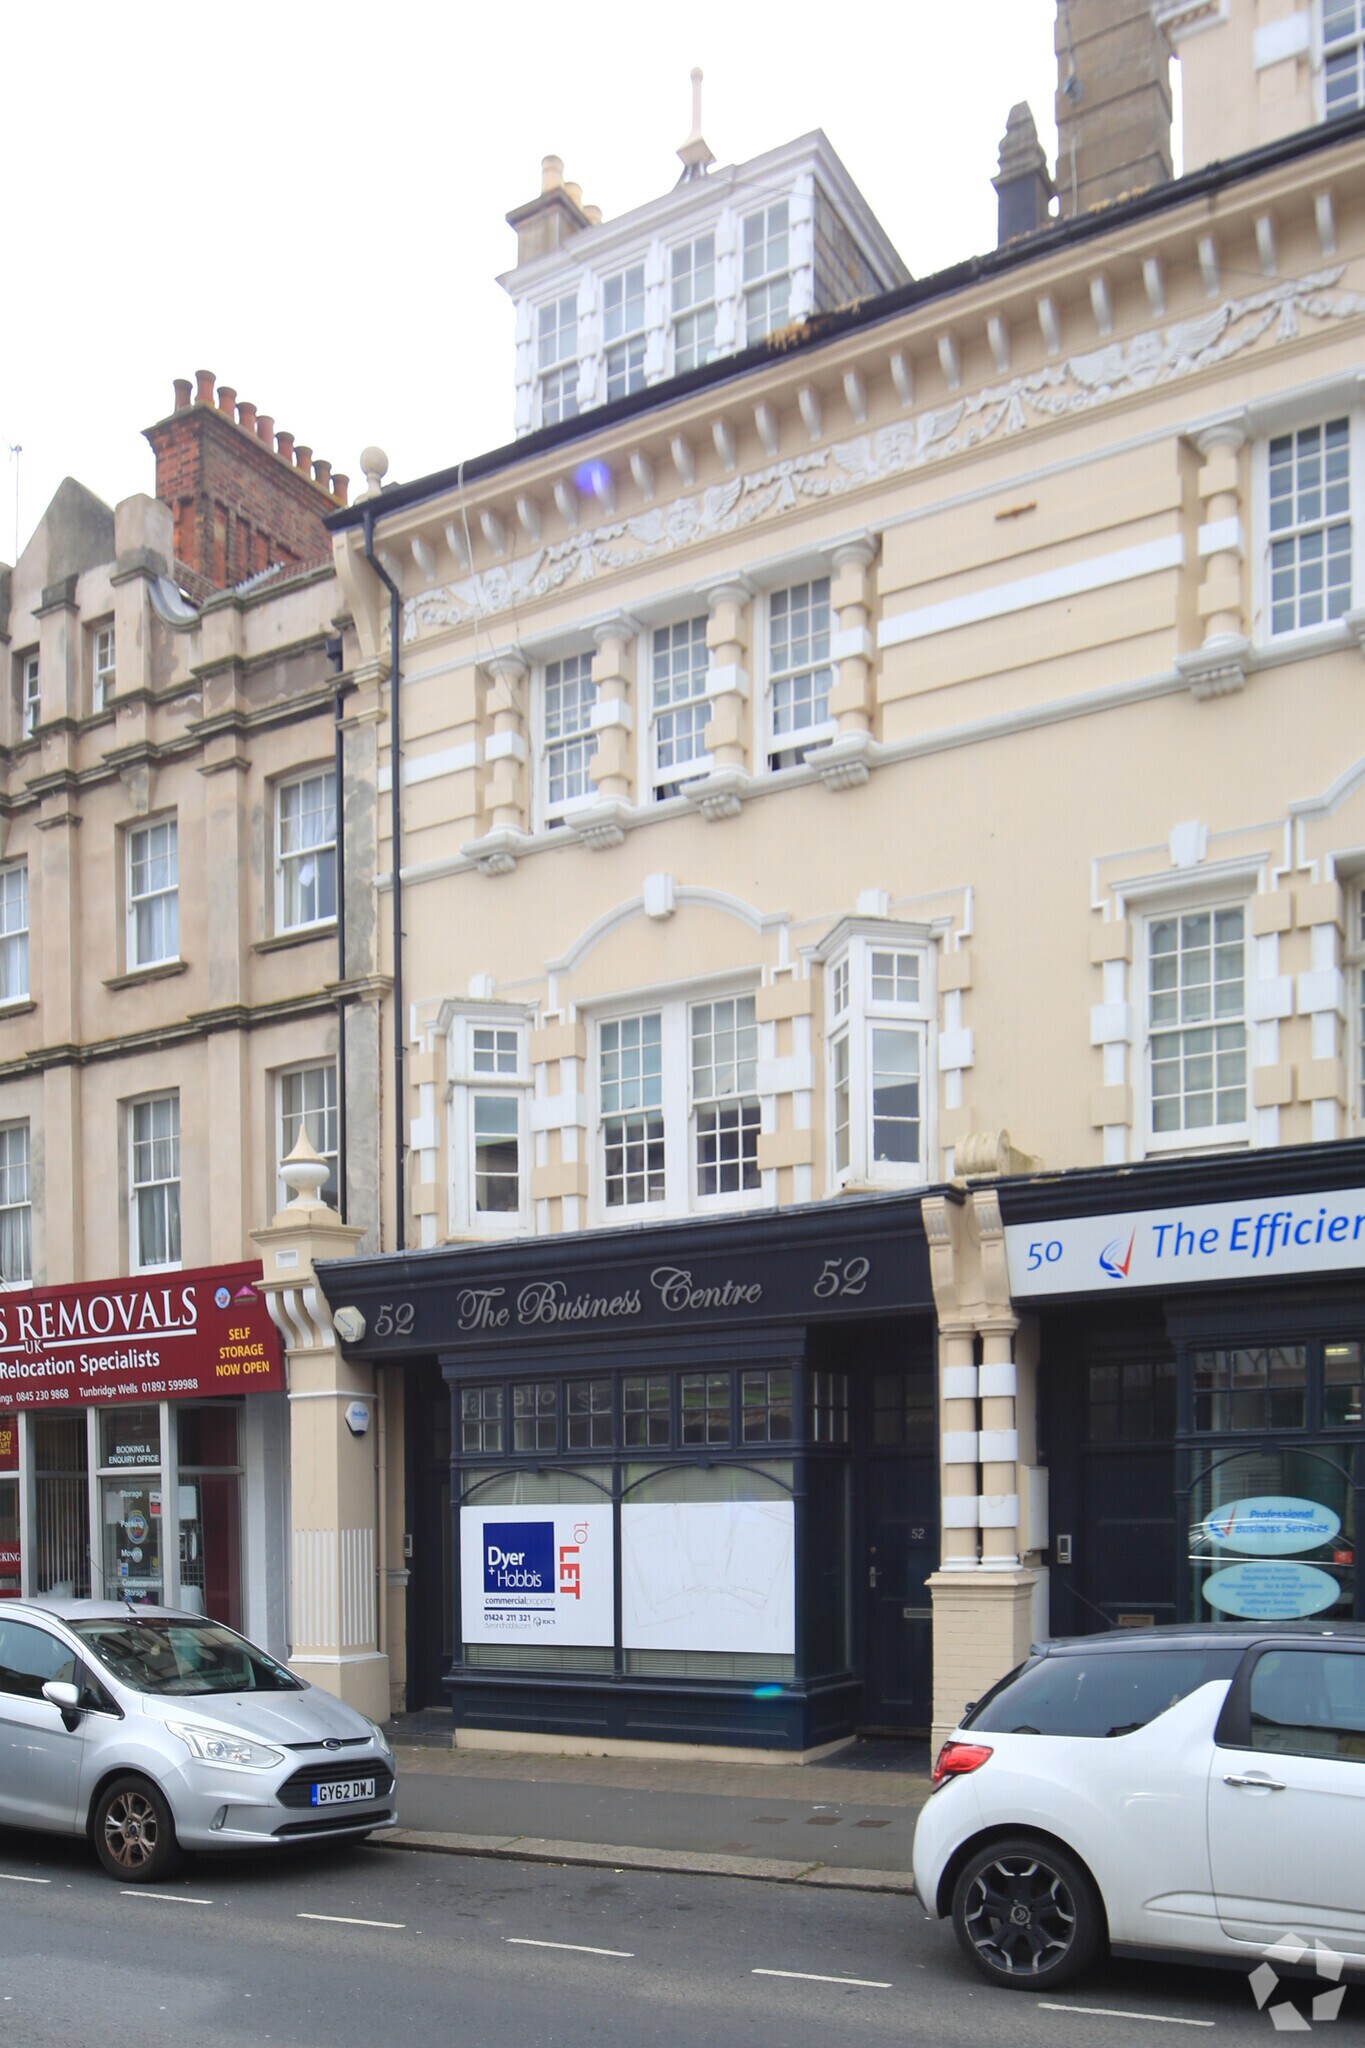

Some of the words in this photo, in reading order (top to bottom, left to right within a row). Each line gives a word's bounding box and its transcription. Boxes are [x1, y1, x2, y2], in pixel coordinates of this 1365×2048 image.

[1153, 1222, 1218, 1258] The
[1027, 1241, 1063, 1270] 50
[813, 1257, 870, 1297] 52
[457, 1287, 511, 1330] The
[517, 1281, 642, 1324] Business
[650, 1266, 763, 1311] Centre
[16, 1287, 198, 1341] REMOVALS
[375, 1303, 415, 1336] 52
[229, 1327, 251, 1340] SELF
[24, 1340, 43, 1354] UK
[220, 1344, 264, 1359] STORAGE
[0, 1356, 75, 1379] Relocation
[80, 1349, 160, 1376] Specialists
[216, 1364, 240, 1376] NOW
[243, 1361, 270, 1374] OPEN
[16, 1391, 34, 1402] 0845
[36, 1390, 49, 1401] 230
[50, 1389, 69, 1400] 9868
[79, 1385, 117, 1398] Tunbridge
[118, 1383, 138, 1395] Wells
[142, 1381, 166, 1393] 01892
[168, 1379, 198, 1391] 599988
[116, 1445, 145, 1454] BOOKING
[146, 1445, 150, 1453] &
[109, 1456, 135, 1464] ENQUIRY
[136, 1455, 159, 1463] OFFICE
[120, 1490, 142, 1499] Storage
[1250, 1508, 1314, 1519] Professional
[574, 1522, 589, 1544] to
[911, 1528, 925, 1539] 52
[1235, 1524, 1281, 1534] Business
[1284, 1523, 1329, 1533] Services
[0, 1552, 20, 1563] KING
[488, 1546, 525, 1570] Dyer
[498, 1569, 542, 1587] Hobbis
[560, 1546, 580, 1600] LET
[124, 1589, 147, 1598] Storage
[484, 1614, 503, 1622] 01424
[506, 1614, 516, 1622] 211
[519, 1614, 531, 1622] 321
[319, 1784, 350, 1801] GY62
